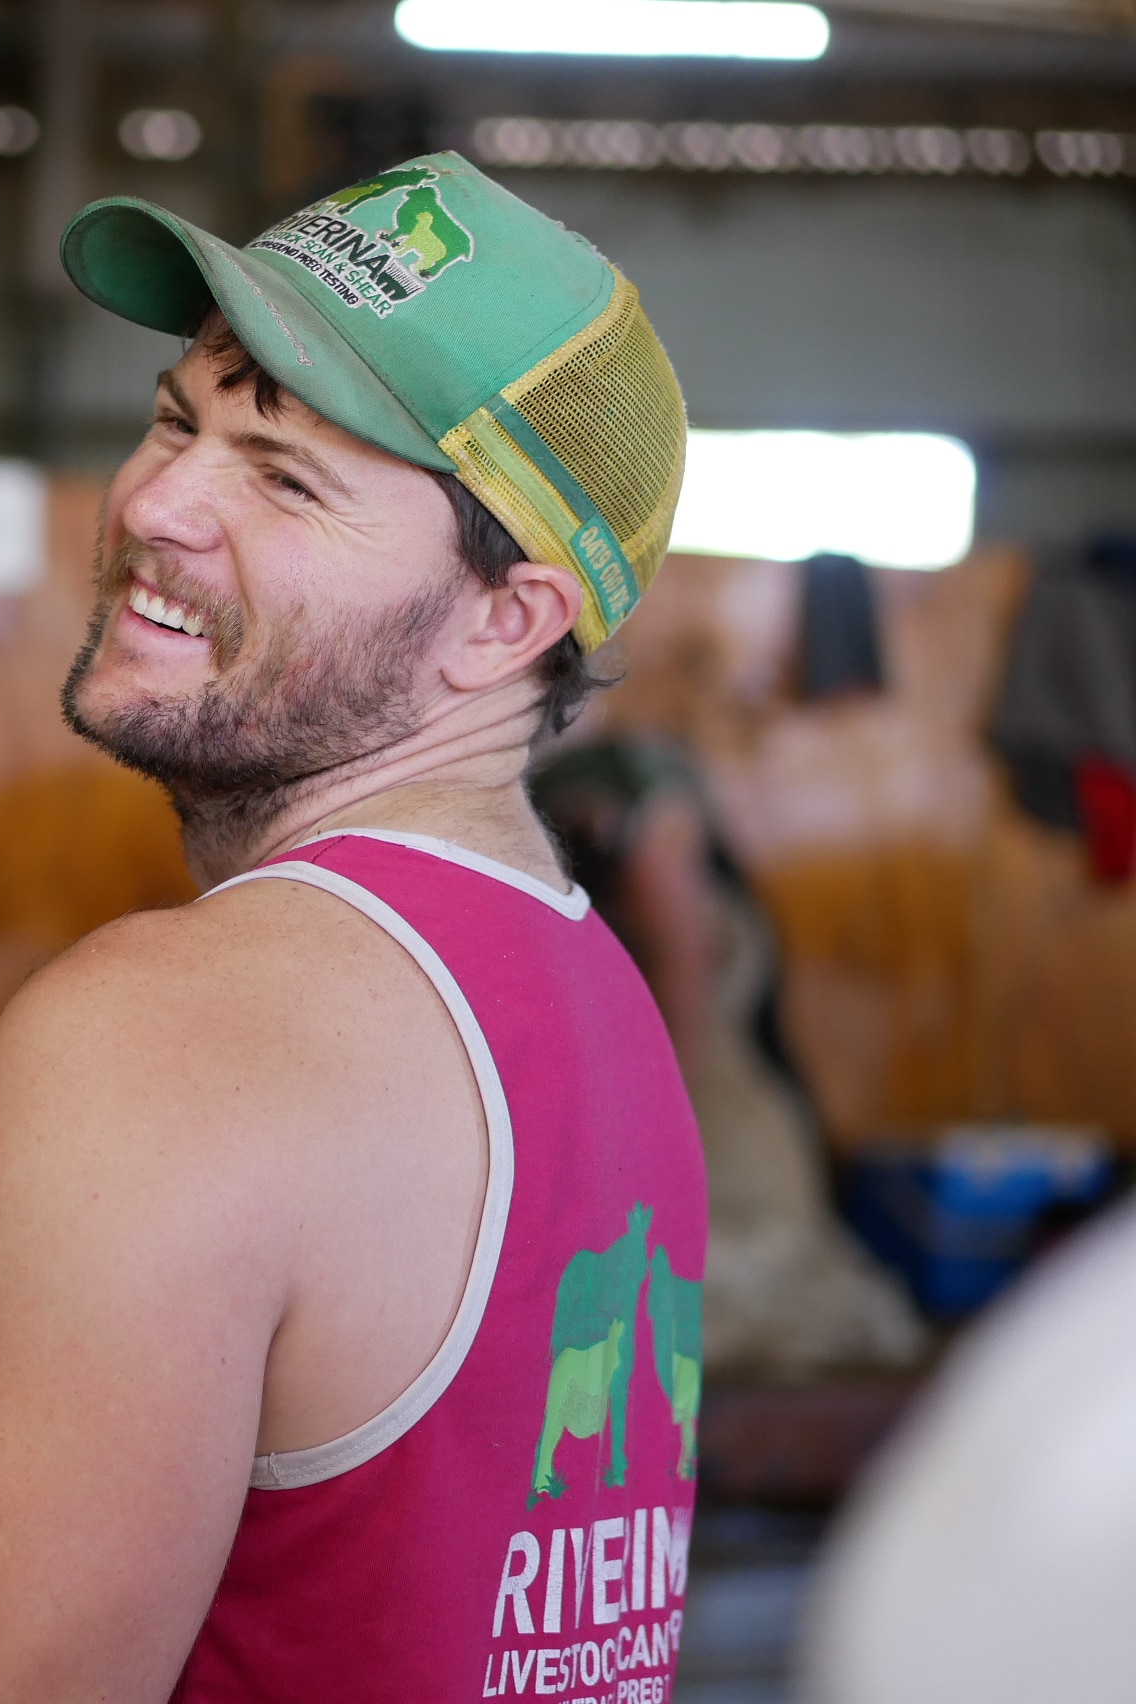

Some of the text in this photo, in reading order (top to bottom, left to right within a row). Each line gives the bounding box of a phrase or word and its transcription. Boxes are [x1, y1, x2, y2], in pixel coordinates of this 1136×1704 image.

[294, 252, 323, 272] PREG
[319, 269, 359, 305] TESTING
[301, 240, 339, 264] SCAN
[334, 261, 348, 275] &
[345, 271, 392, 315] SHEAR
[482, 1638, 616, 1698] LIVESTOC
[616, 1621, 670, 1671] CAN
